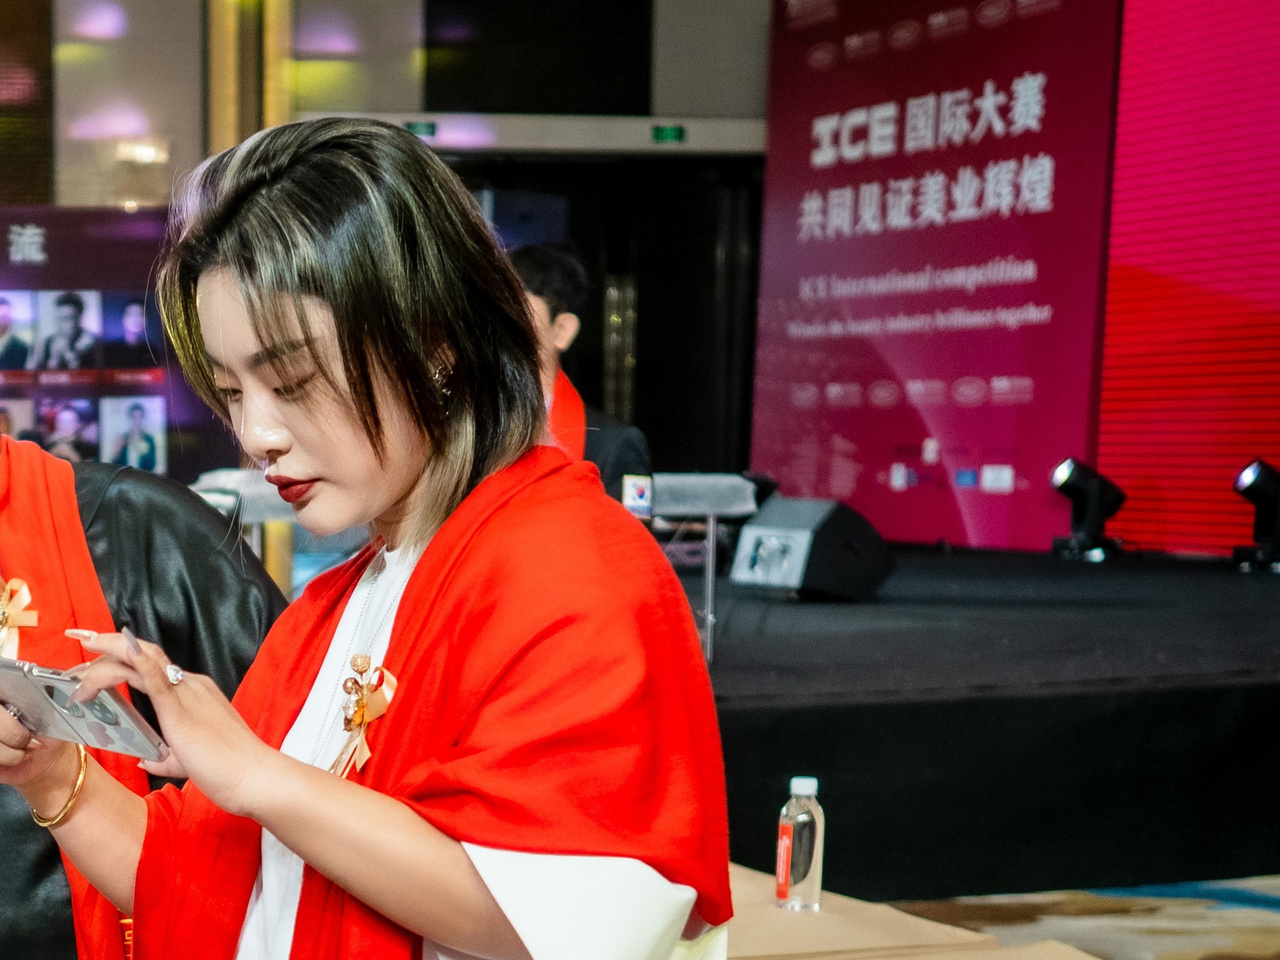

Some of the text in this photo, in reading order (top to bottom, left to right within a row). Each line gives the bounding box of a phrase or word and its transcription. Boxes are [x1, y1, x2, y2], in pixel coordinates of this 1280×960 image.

[811, 70, 1047, 170] ICE 国际大赛
[796, 152, 1056, 242] 共同见证美业辉煌
